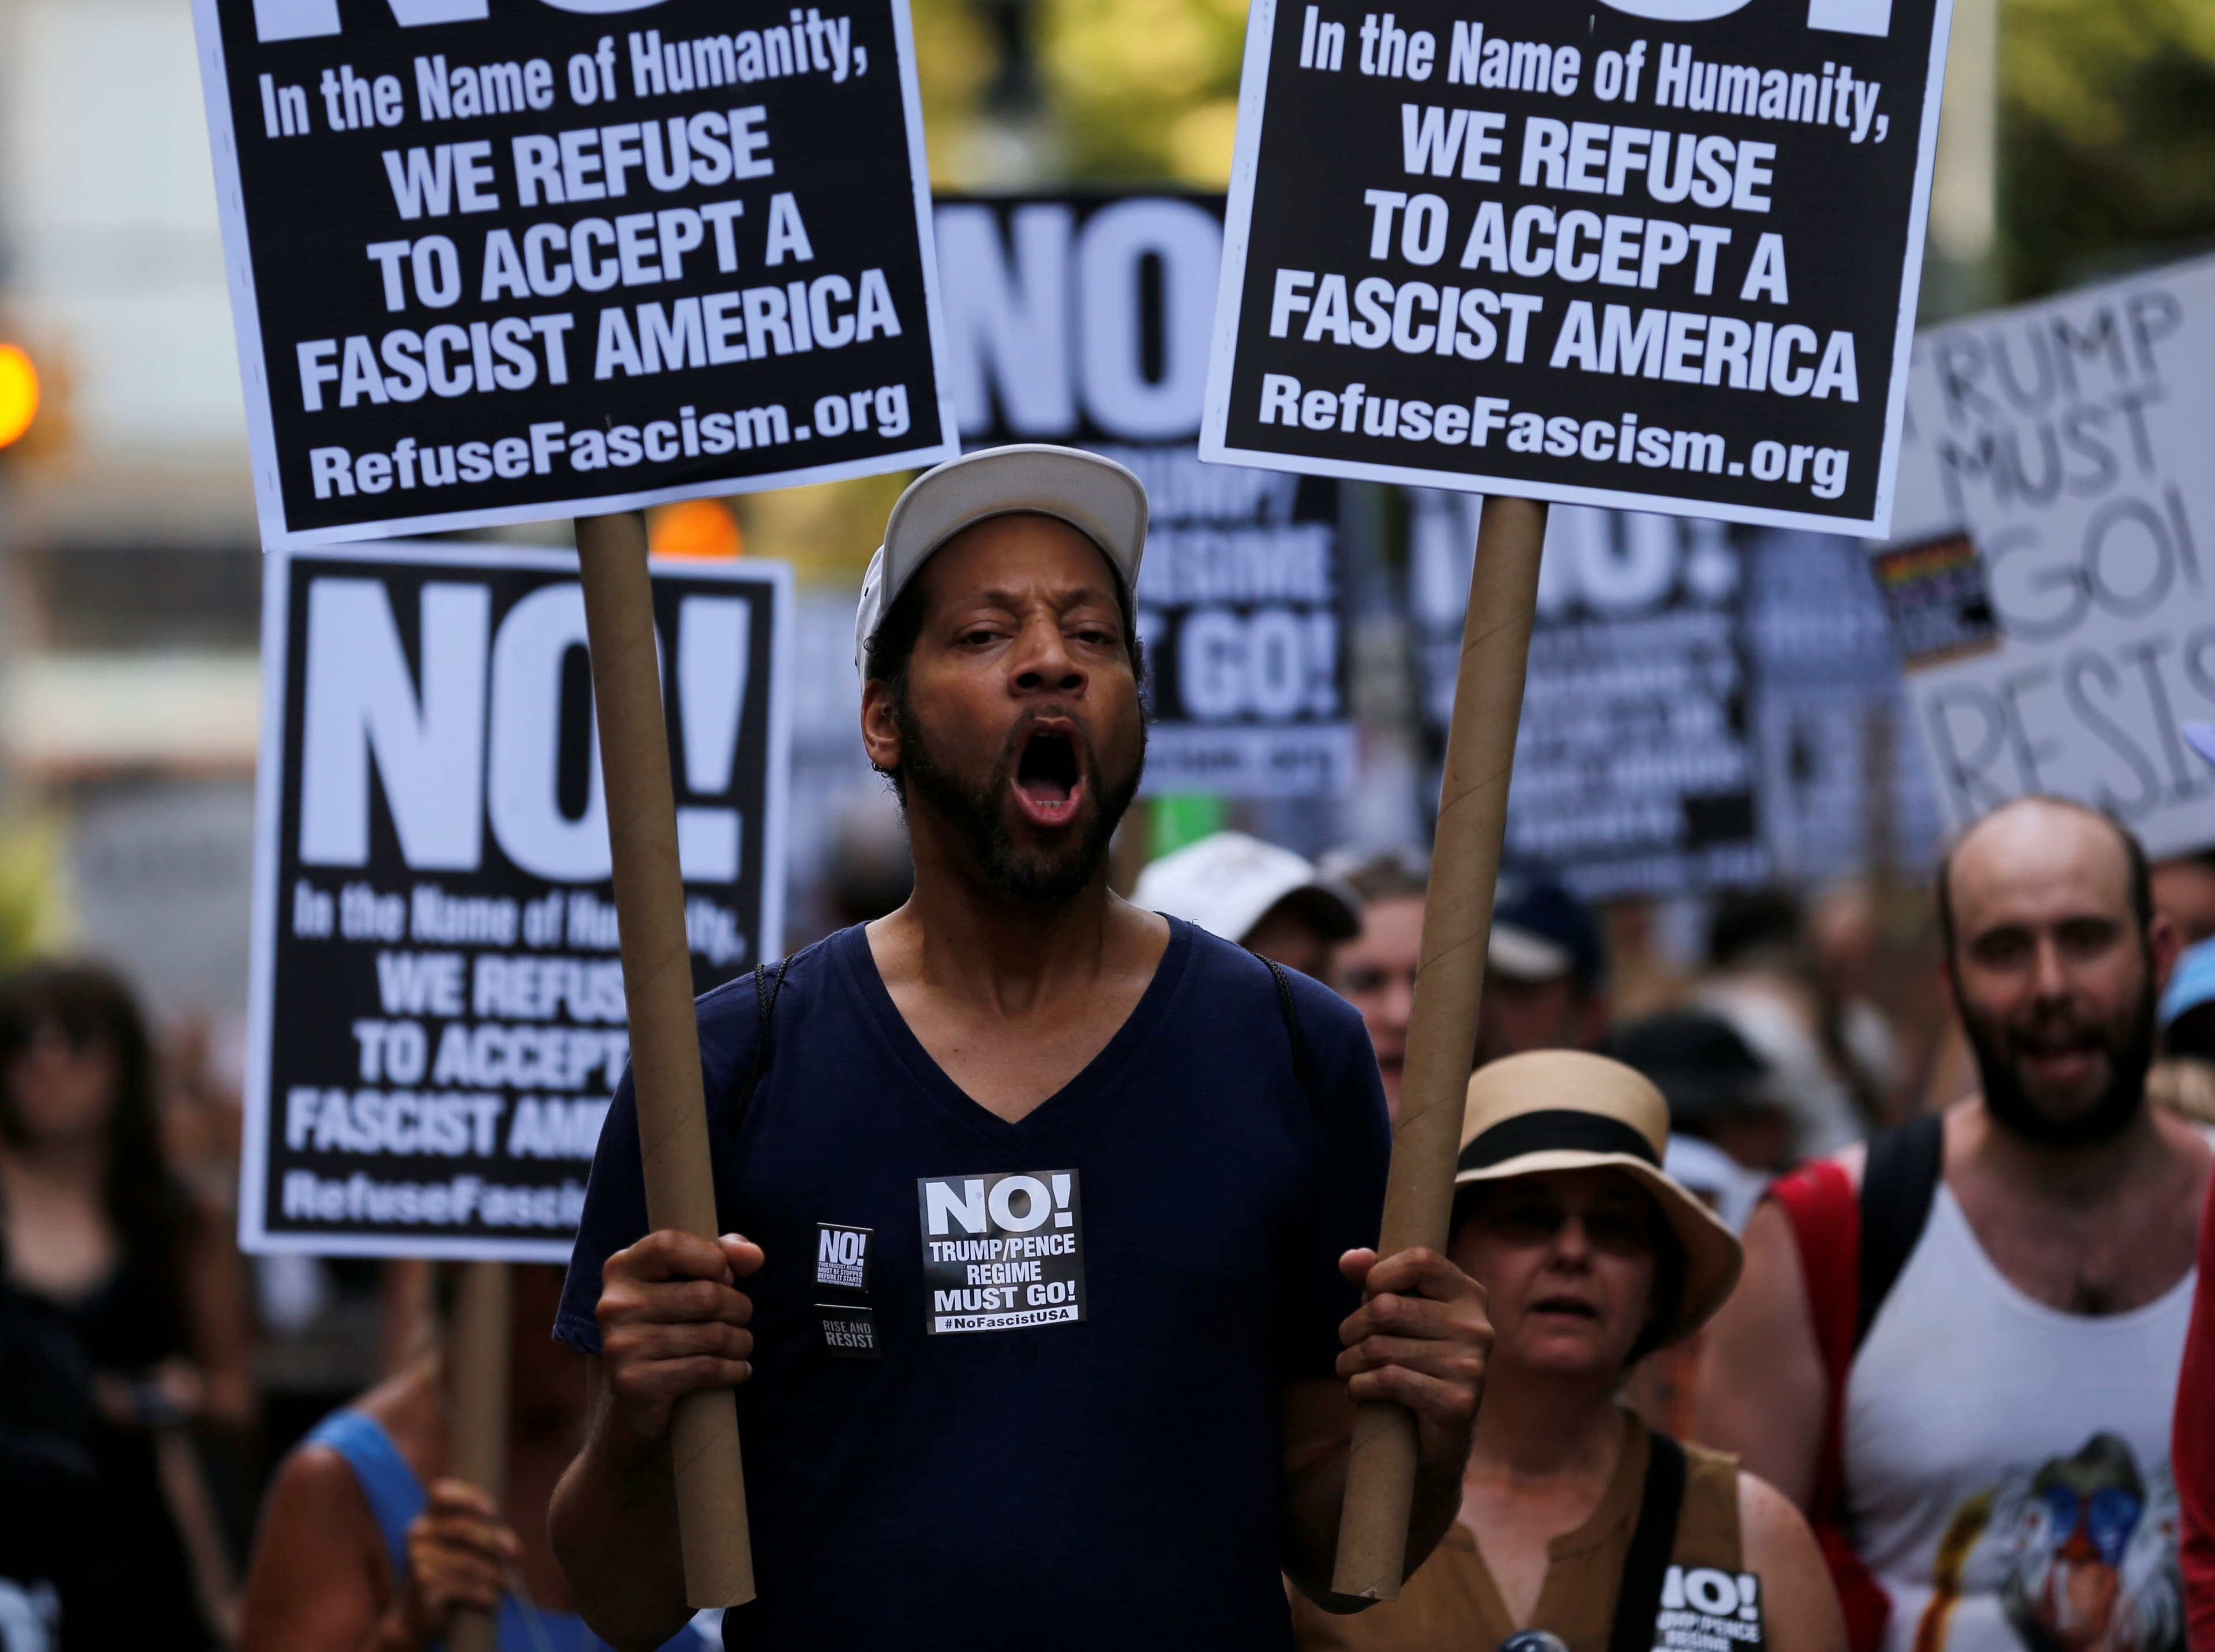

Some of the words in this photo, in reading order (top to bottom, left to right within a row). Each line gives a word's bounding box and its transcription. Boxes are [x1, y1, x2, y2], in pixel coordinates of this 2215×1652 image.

[260, 74, 309, 137] In
[321, 65, 403, 130] the
[415, 55, 553, 120] Name
[568, 36, 615, 104] of
[629, 9, 866, 96] Humanity,
[1300, 6, 1345, 71] In
[1360, 13, 1435, 81] the
[1448, 21, 1580, 96] Name
[1594, 40, 1646, 102] of
[1655, 43, 1889, 143] Humanity,
[382, 141, 499, 219] WE
[512, 106, 774, 206] REFUSE
[1402, 104, 1506, 182] WE
[1519, 117, 1776, 212] REFUSE
[367, 235, 460, 311] TO
[482, 200, 743, 301] ACCEPT
[766, 193, 813, 265] A
[1365, 189, 1448, 265] TO
[1461, 201, 1732, 295] ACCEPT
[1740, 233, 1788, 304] A
[296, 313, 573, 411] FASCIST
[595, 269, 901, 379] AMERICA
[1270, 269, 1543, 363] FASCIST
[1549, 301, 1859, 402] AMERICA
[1905, 290, 2184, 440] RUMP
[310, 385, 910, 498] RefuseFascism.org
[1259, 374, 1849, 498] RefuseFascism.org
[1935, 382, 2169, 524] MUST
[299, 577, 752, 883] NO!
[340, 880, 406, 943] the
[410, 883, 519, 947] Name
[523, 888, 565, 948] of
[376, 951, 465, 1018] WE
[472, 953, 629, 1023] REFUS
[352, 1018, 428, 1087] TO
[431, 1021, 632, 1091] ACCEPT
[287, 1085, 506, 1159] FASCIST
[925, 1174, 1072, 1235] NO!
[819, 1229, 866, 1266] NO!
[840, 1270, 863, 1278] STOPPED
[843, 1275, 862, 1283] STARTS
[929, 1233, 1075, 1261] TRUMP/PENCE
[967, 1261, 1042, 1285] REGIME
[823, 1320, 847, 1332] RISE
[850, 1322, 871, 1334] AND
[934, 1286, 1018, 1312] MUST
[1027, 1281, 1075, 1305] GO!
[945, 1309, 1070, 1329] #NoFascistUSA
[825, 1331, 873, 1348] RESIST
